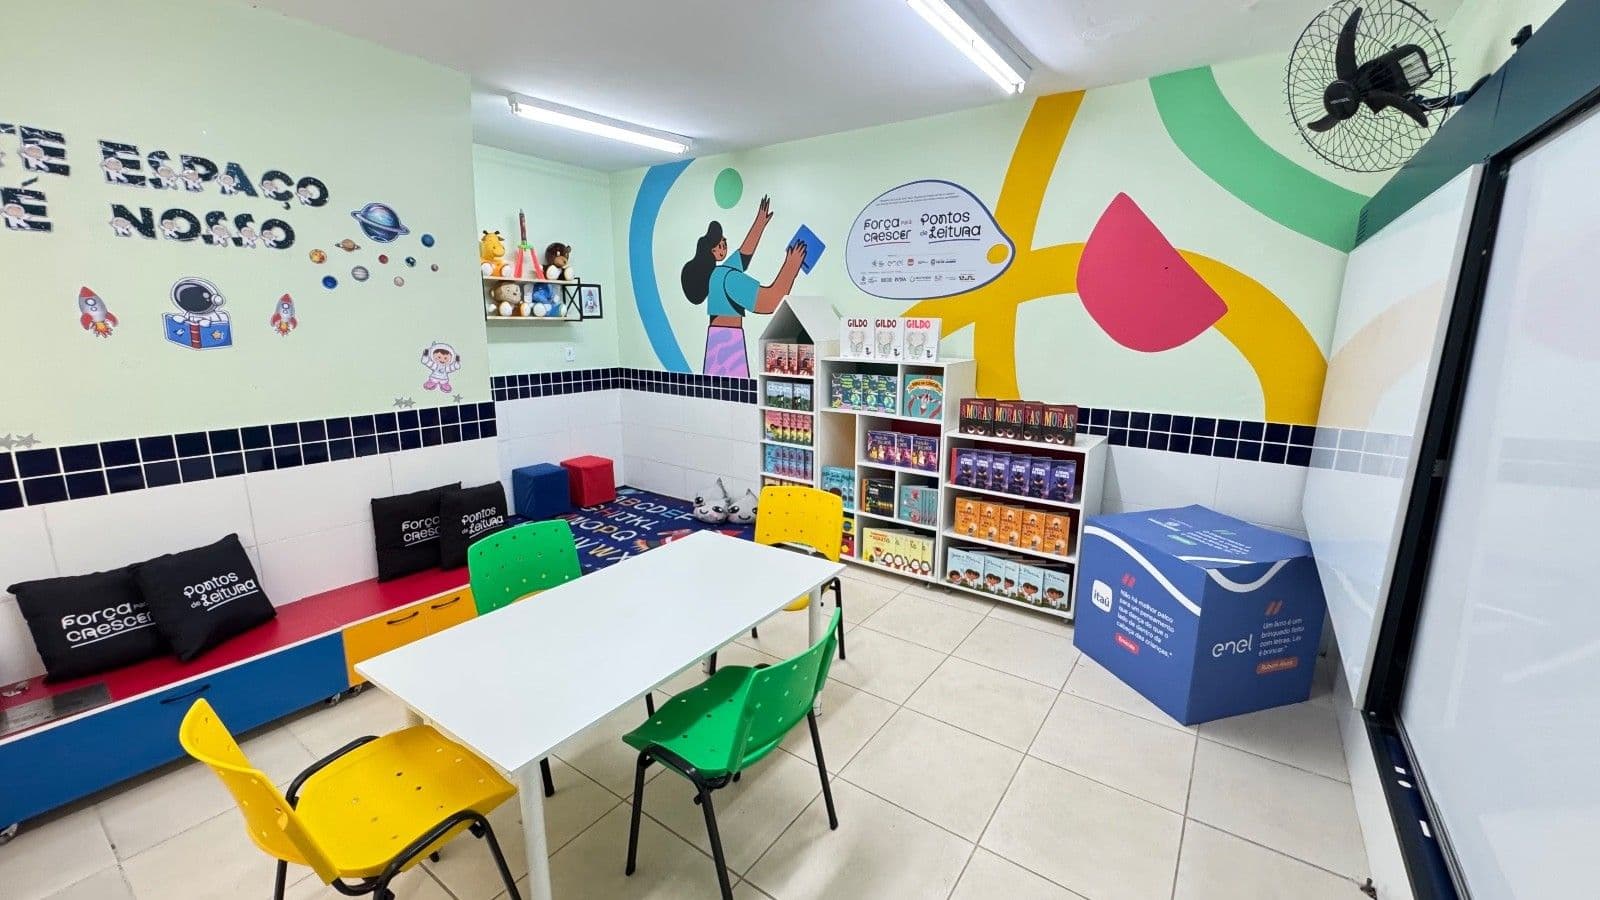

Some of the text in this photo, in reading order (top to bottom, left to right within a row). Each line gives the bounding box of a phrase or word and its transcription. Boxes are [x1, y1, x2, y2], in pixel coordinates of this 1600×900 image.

[98, 139, 330, 211] ESPAÇO
[110, 203, 296, 250] NOSSO
[847, 319, 868, 328] GILDO
[875, 319, 897, 328] GILDO
[906, 319, 931, 329] GILDO
[995, 406, 1023, 424] MORAS
[1025, 410, 1040, 426] RAS
[1044, 410, 1074, 429] MORAS
[1093, 590, 1110, 608] itaú
[1212, 633, 1253, 658] enel
